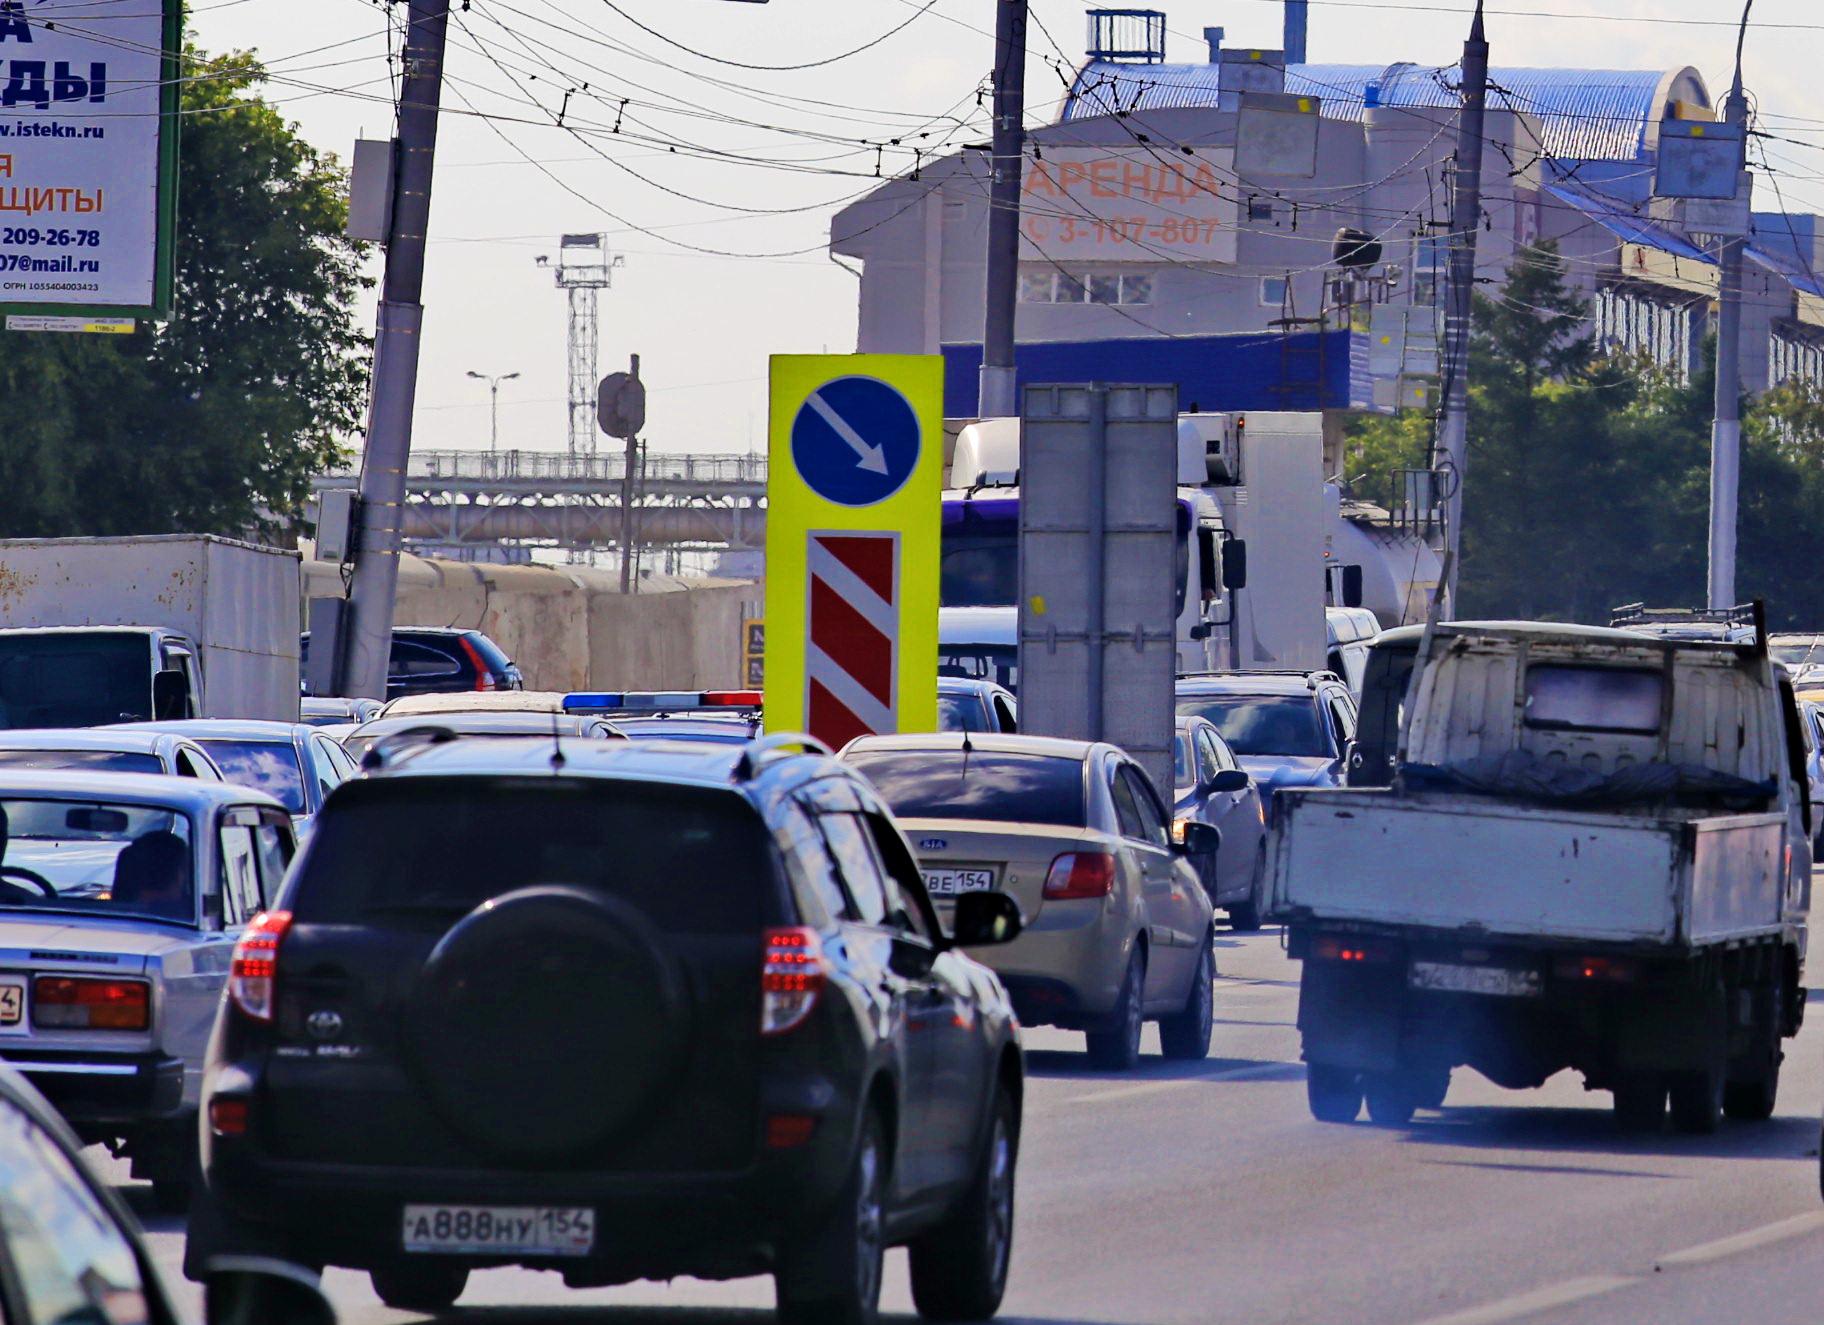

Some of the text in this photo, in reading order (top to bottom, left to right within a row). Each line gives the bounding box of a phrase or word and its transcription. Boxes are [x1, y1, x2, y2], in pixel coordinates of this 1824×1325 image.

[0, 60, 107, 110] ДЫ
[1022, 161, 1221, 205] АРЕНДА
[3, 227, 100, 247] 209-26-78
[1058, 216, 1221, 246] 3-107-807
[3, 282, 26, 291] ОГРН
[956, 873, 987, 888] 154
[413, 1209, 591, 1242] А888НУ 154
